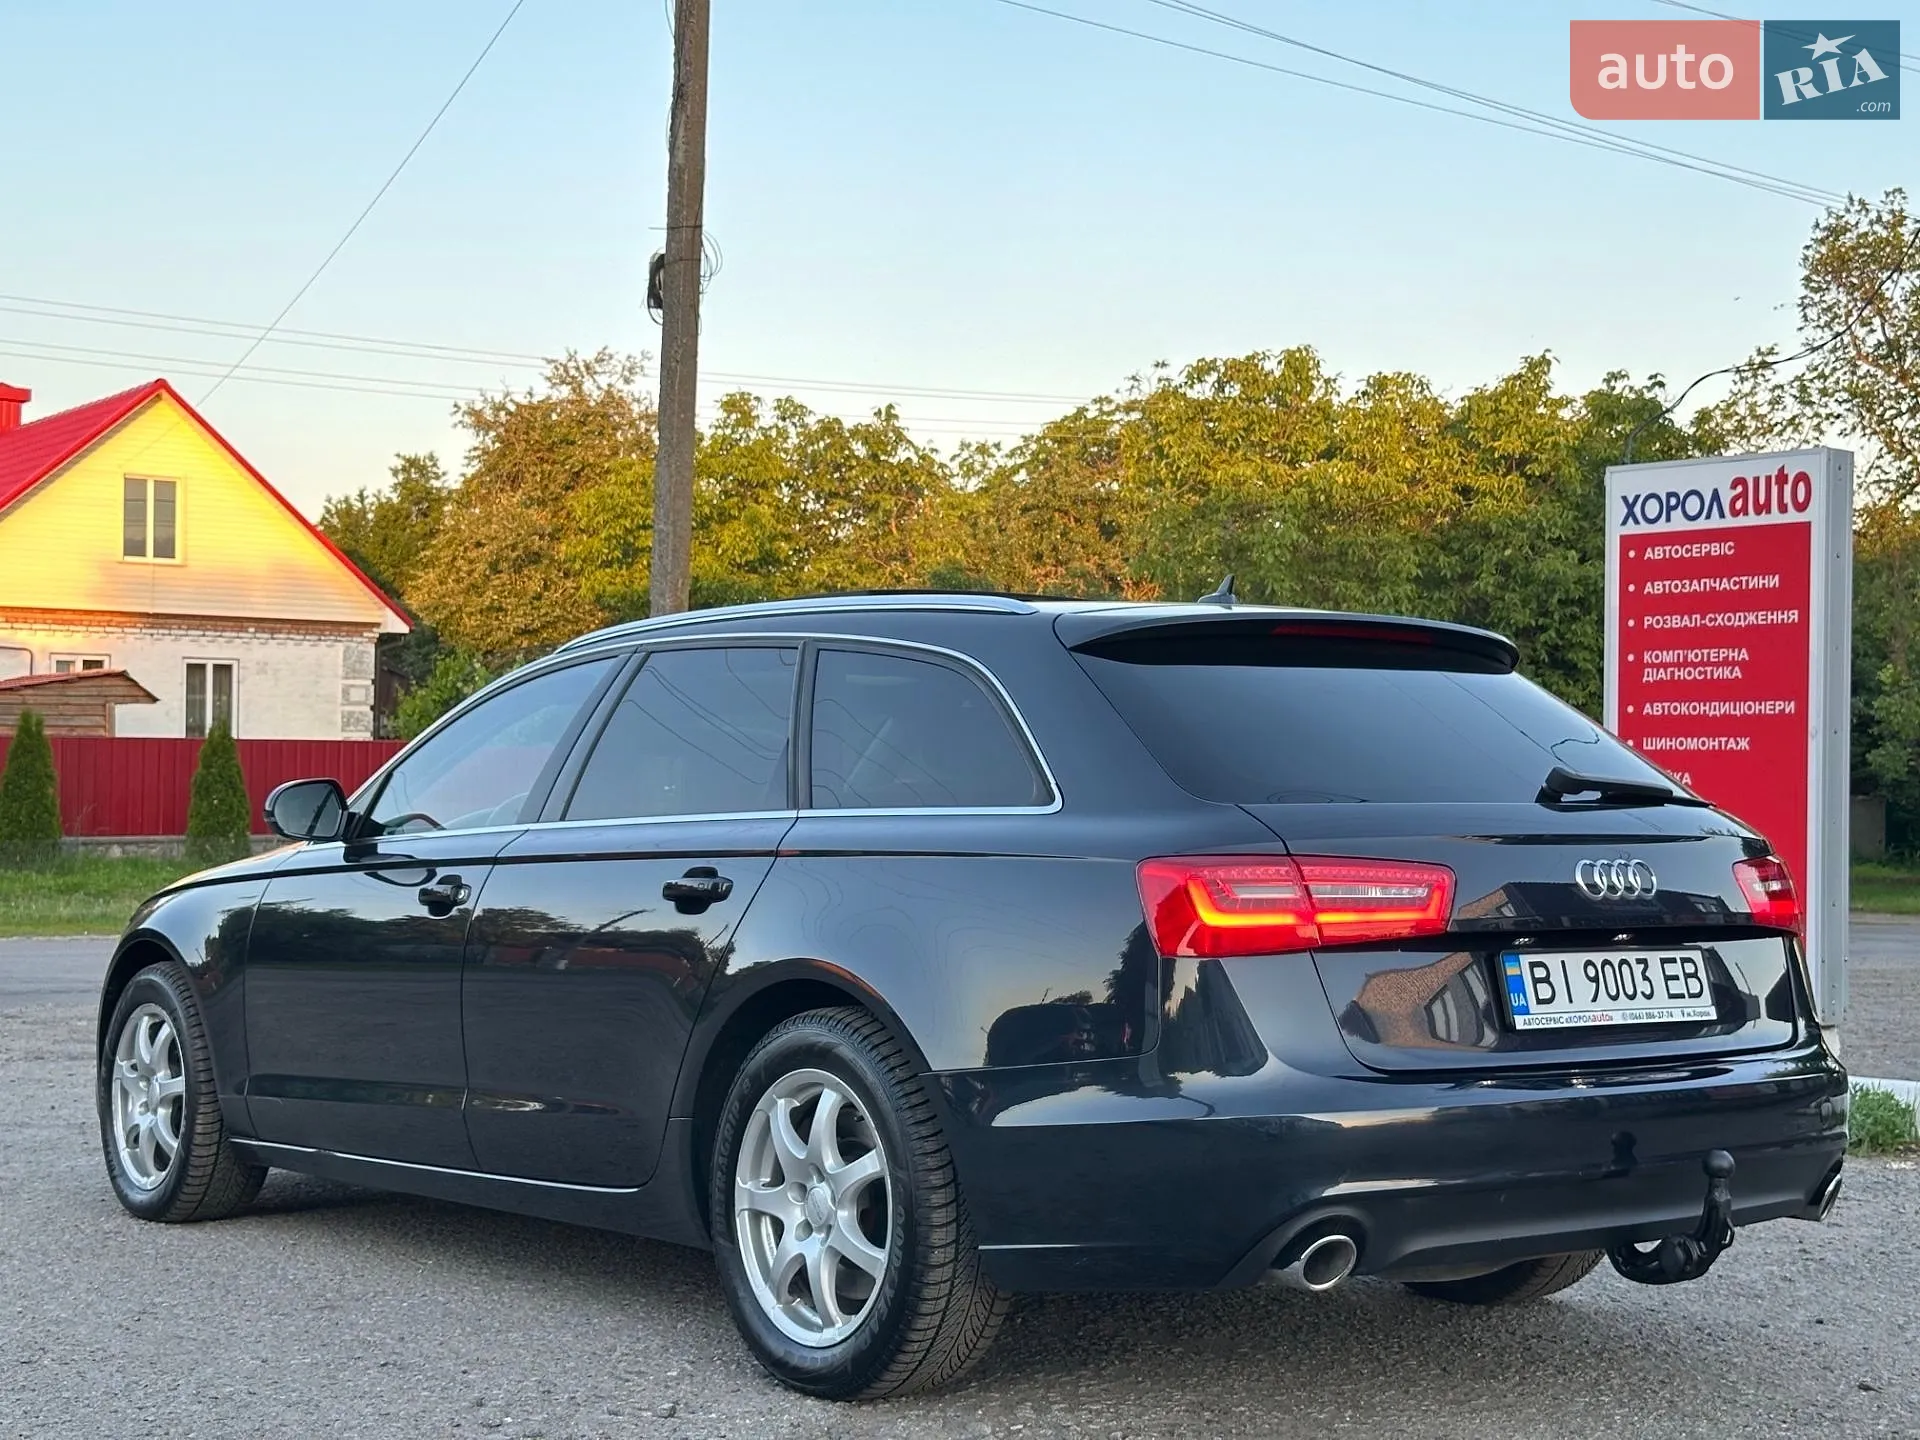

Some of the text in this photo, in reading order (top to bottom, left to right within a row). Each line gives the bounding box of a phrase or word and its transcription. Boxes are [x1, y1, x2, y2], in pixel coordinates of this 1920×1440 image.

[1644, 541, 1735, 561] АВТОСЕРВІС
[1644, 574, 1779, 595] АВТОЗАПЧАСТИНИ
[1643, 609, 1799, 629] РОЗВАЛ-СХОДЖЕННЯ
[1643, 666, 1742, 683] ДІАГНОСТИКА
[1643, 700, 1796, 717] АВТОКОНДИЦІОНЕРИ
[1643, 737, 1750, 751] ШИНОМОНТАЖ
[1583, 957, 1655, 1003] 9003
[1659, 956, 1704, 1000] EB
[1511, 993, 1527, 1007] UA
[1522, 1016, 1564, 1027] АВТОСЕРВІС
